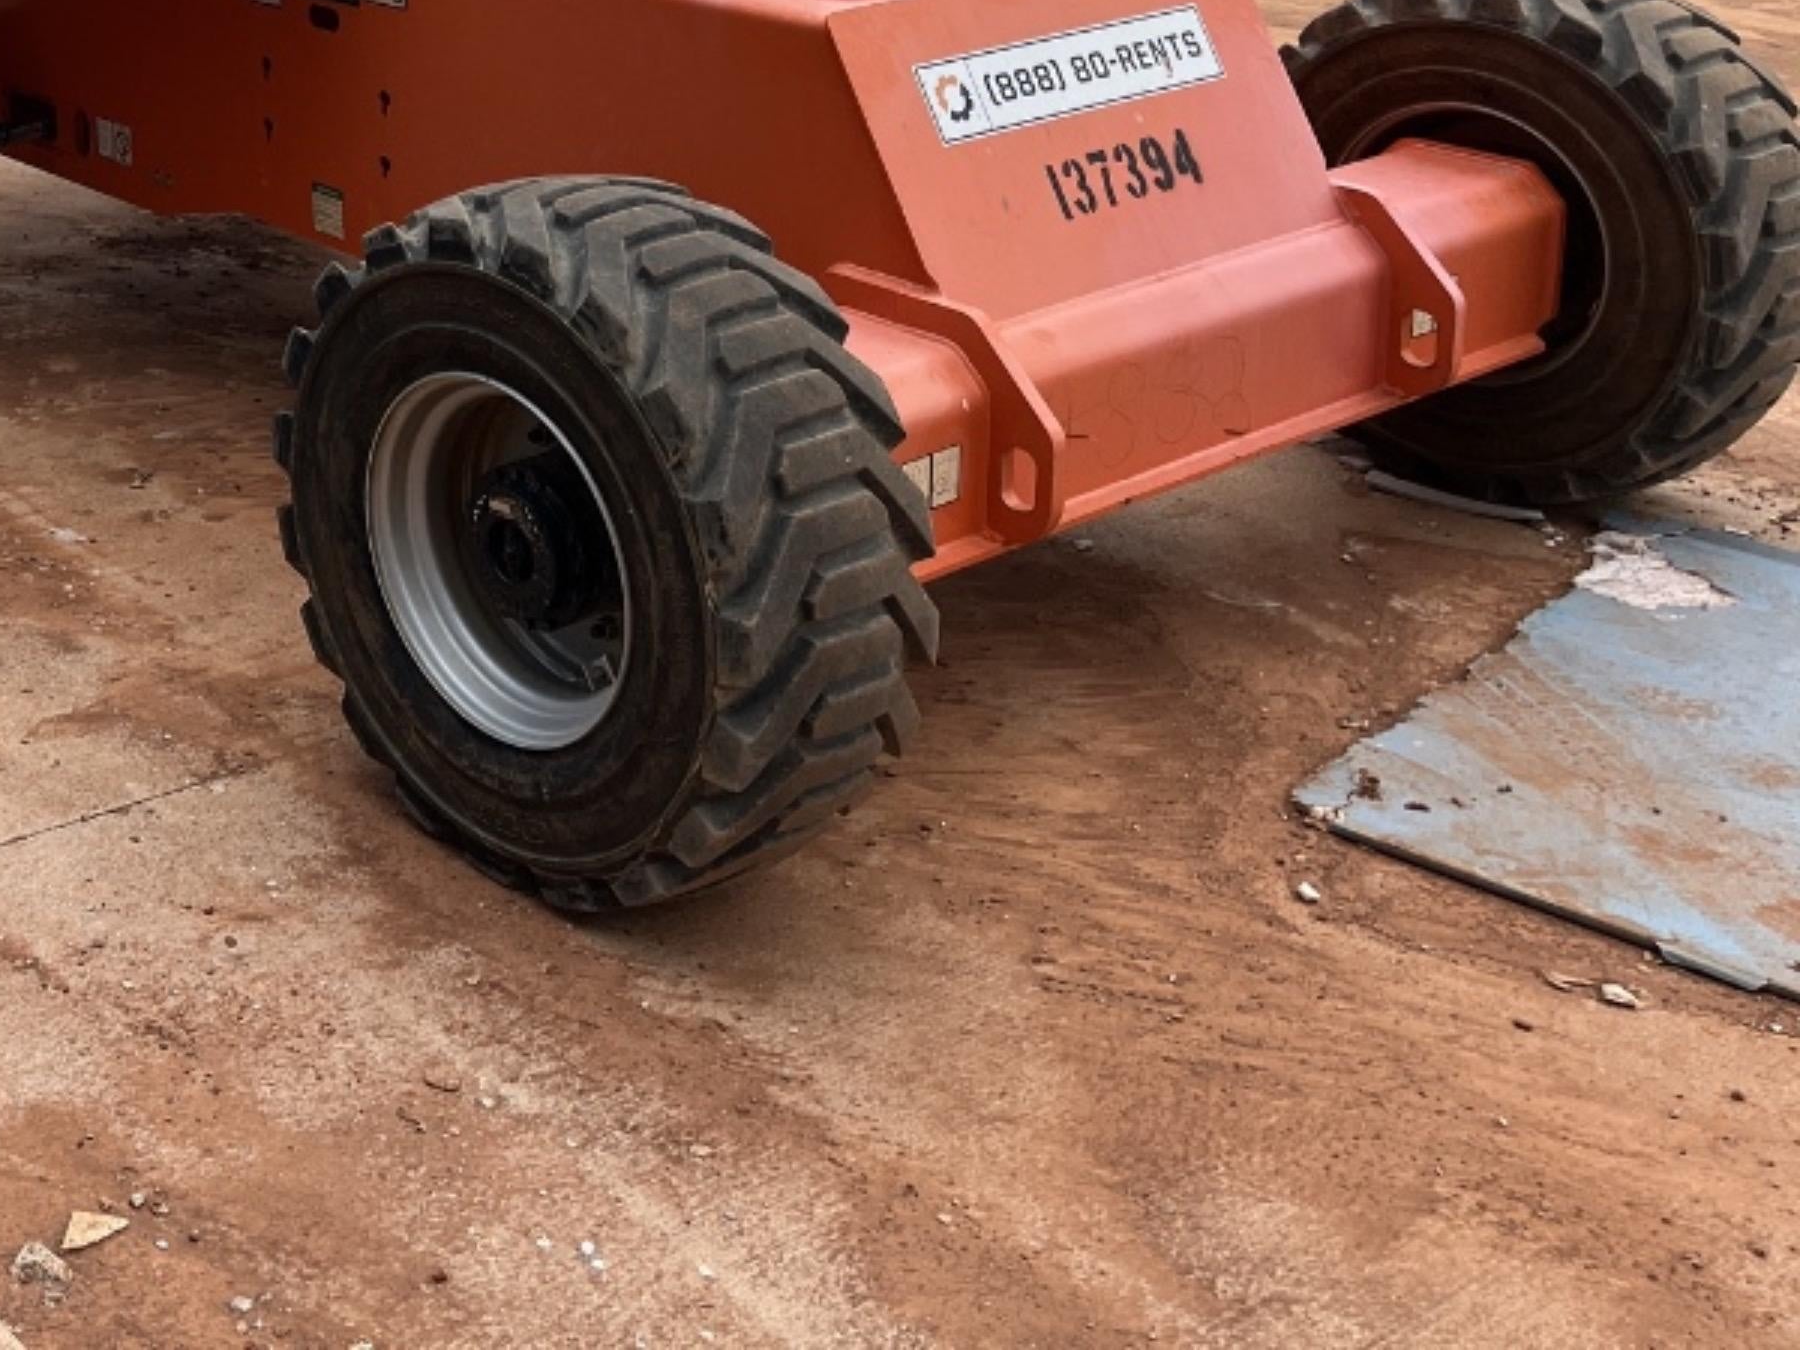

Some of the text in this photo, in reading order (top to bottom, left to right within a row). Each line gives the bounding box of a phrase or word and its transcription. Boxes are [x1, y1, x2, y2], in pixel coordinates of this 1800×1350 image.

[983, 30, 1203, 107] (888) 80-RENTS
[1045, 127, 1204, 221] 137394
